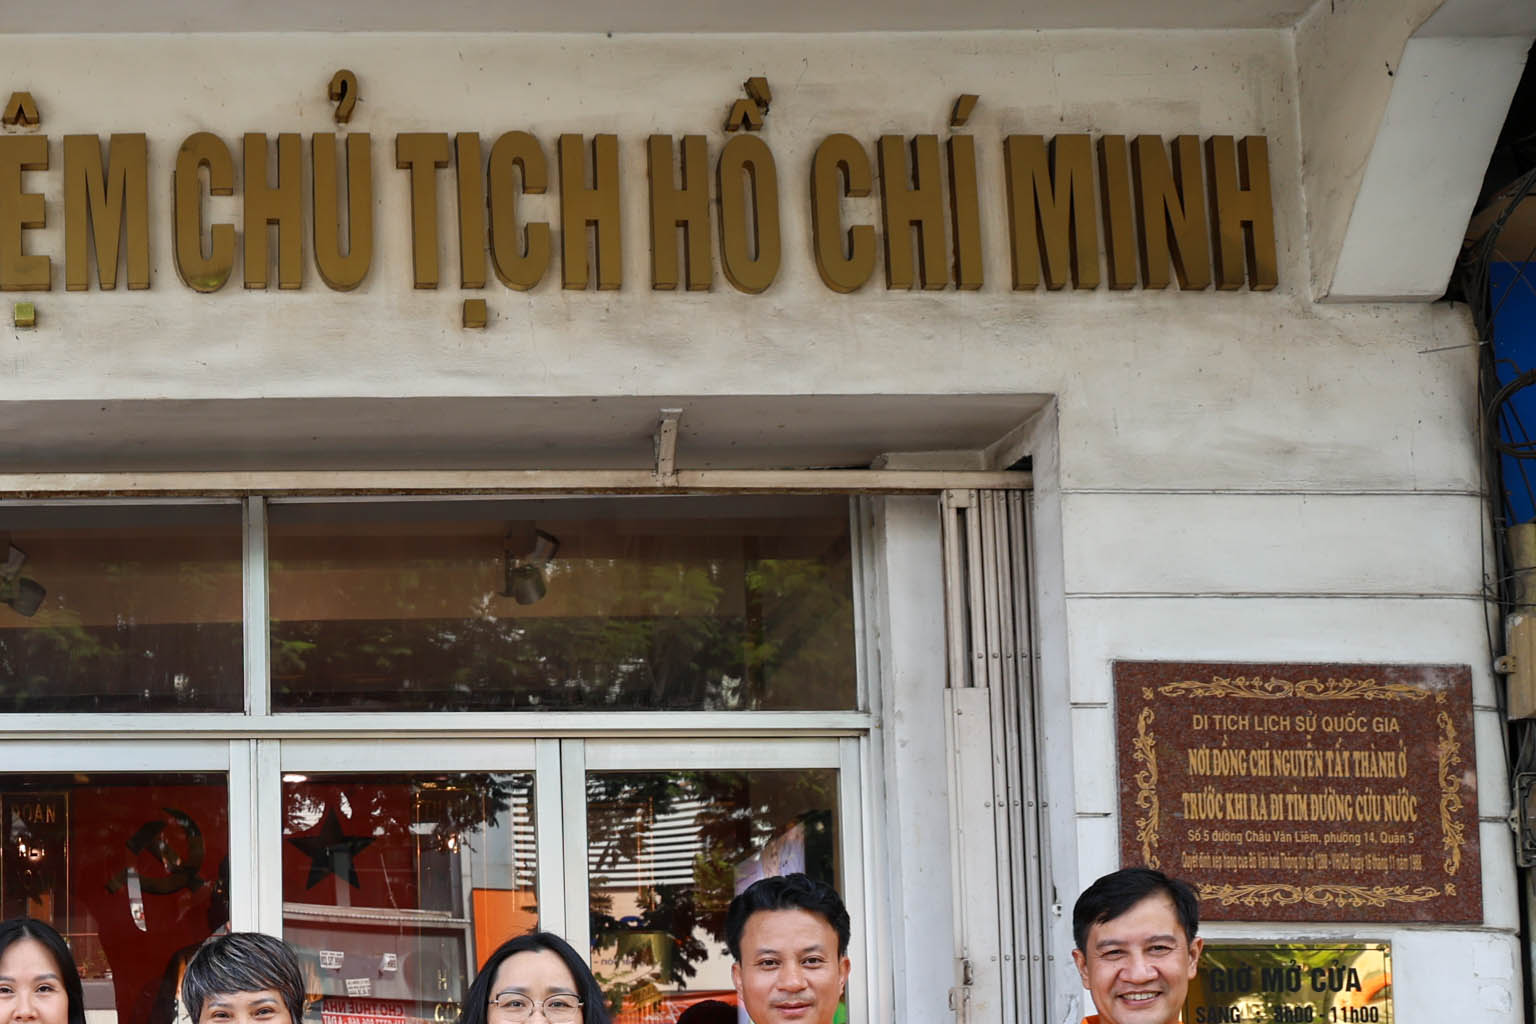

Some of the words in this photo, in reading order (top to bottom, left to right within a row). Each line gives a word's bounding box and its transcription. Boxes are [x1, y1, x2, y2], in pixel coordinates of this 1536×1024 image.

[171, 69, 372, 294] CHỦ
[395, 130, 622, 329] TỊCH
[647, 76, 782, 296] HỒ
[811, 93, 984, 296] CHÍ
[1003, 133, 1278, 293] MINH
[1192, 714, 1209, 731] DI
[1254, 715, 1291, 734] LỊCH
[1295, 710, 1317, 732] SỬ
[1321, 710, 1368, 733] QUỐC
[1372, 717, 1400, 733] GIA
[1188, 743, 1211, 776] NƠI
[1212, 734, 1247, 777] ĐỒNG
[1249, 741, 1271, 777] CHÍ
[1325, 737, 1350, 778] TẤT
[1353, 743, 1396, 778] THÀNH
[1181, 784, 1224, 820] TRƯỚC
[1225, 792, 1248, 821] KHI
[1249, 793, 1268, 821] RA
[1269, 793, 1284, 821] ĐI
[1285, 785, 1308, 821] TÌM
[1355, 786, 1381, 822] CỨU
[1383, 787, 1418, 822] NƯỚC
[1204, 829, 1210, 842] 5
[1408, 832, 1415, 844] 5
[1261, 959, 1302, 993] MỞ
[1310, 959, 1362, 993] CỬA
[1331, 1006, 1379, 1023] 11h00
